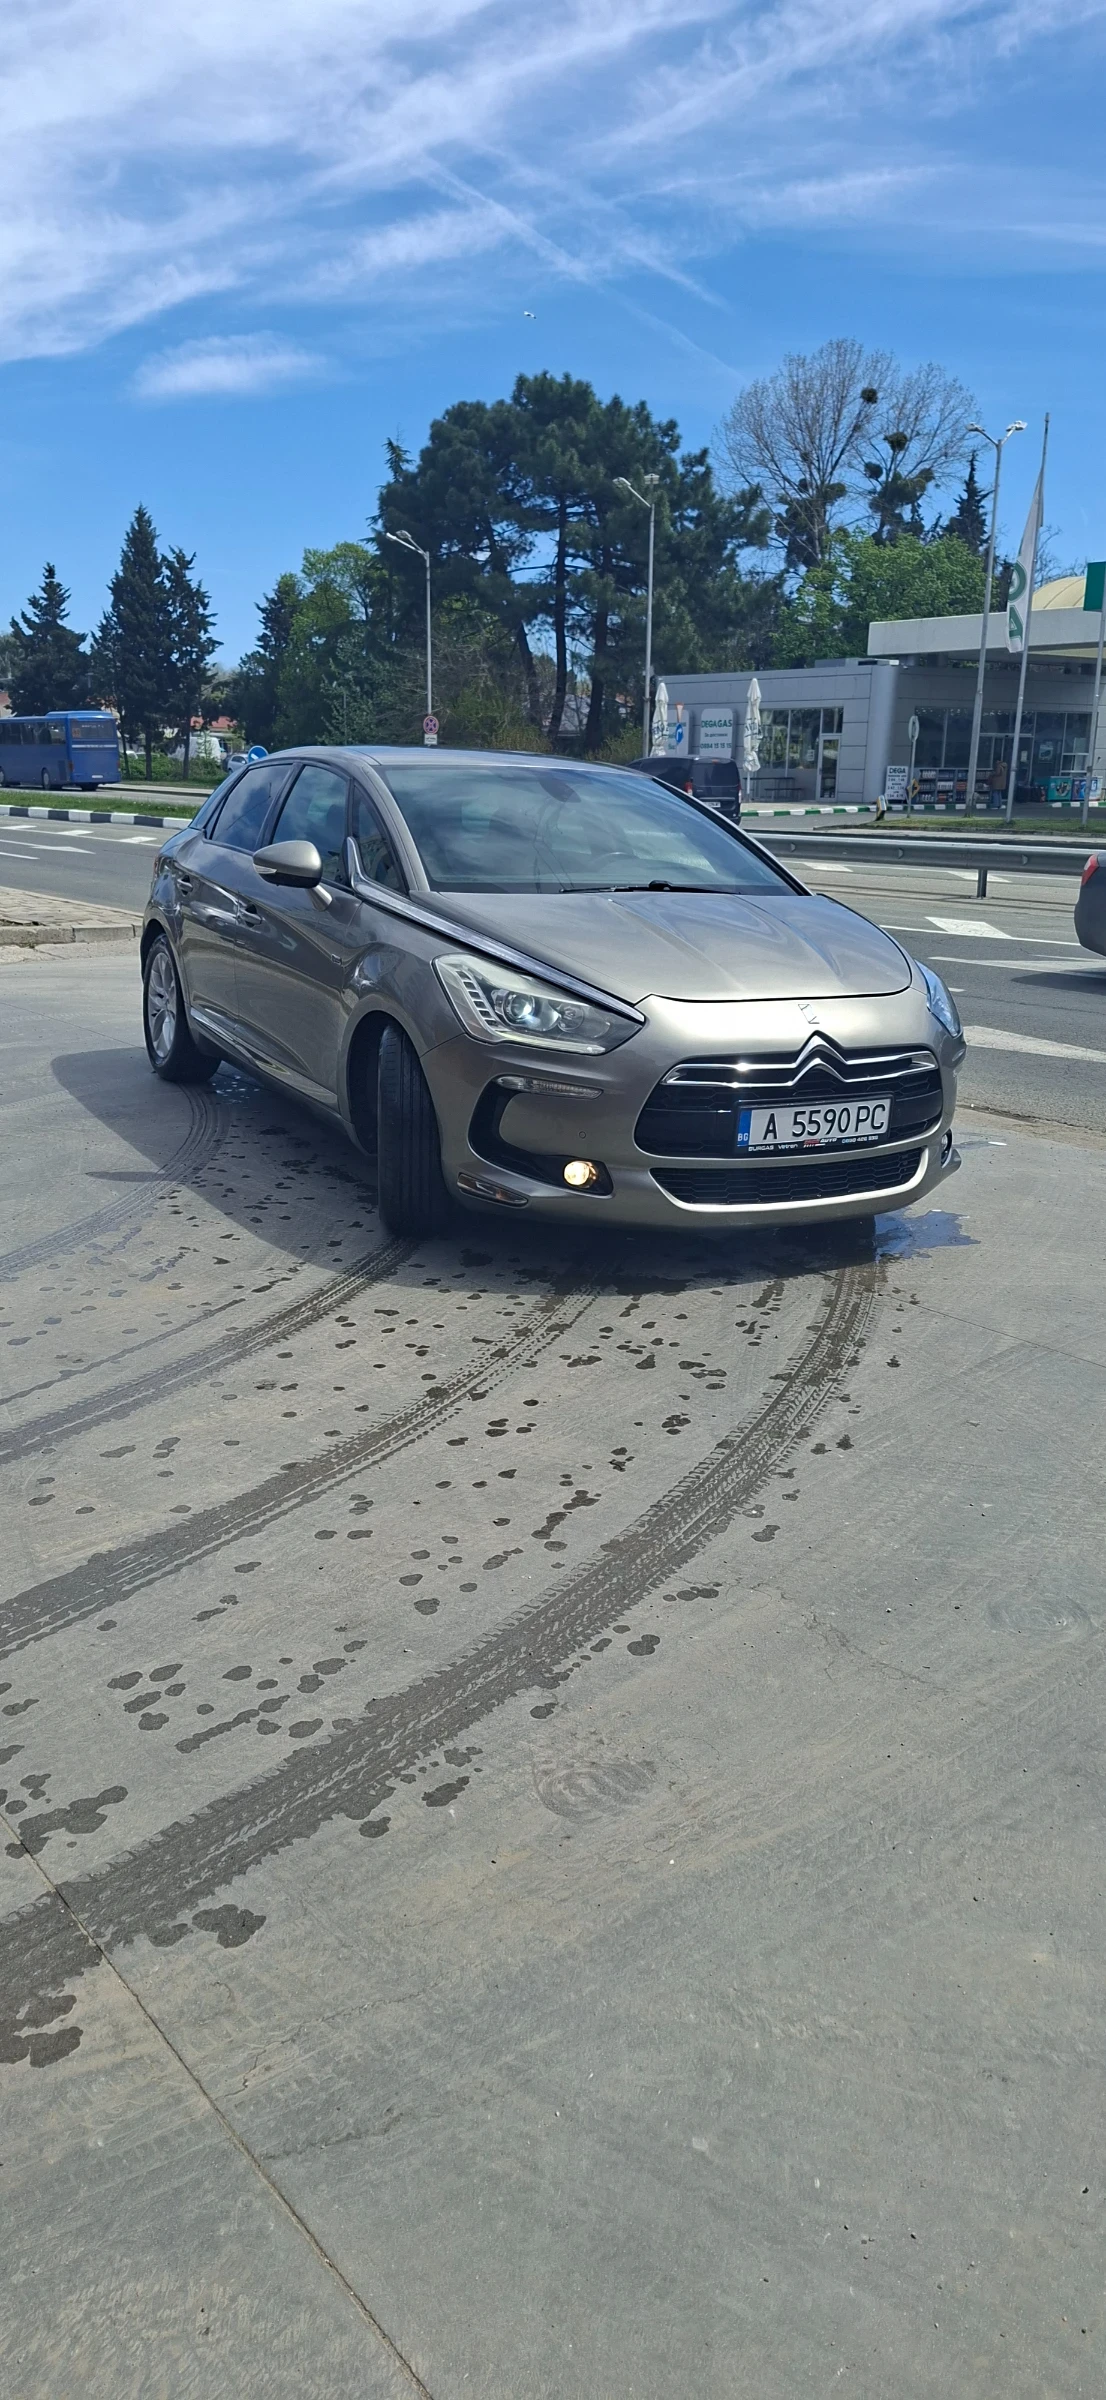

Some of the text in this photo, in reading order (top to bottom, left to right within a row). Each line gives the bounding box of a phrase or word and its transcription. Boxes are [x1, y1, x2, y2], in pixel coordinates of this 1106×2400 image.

[763, 1104, 886, 1141] A 5590 PC
[737, 1132, 749, 1142] BG
[748, 1144, 774, 1152] BURGAS
